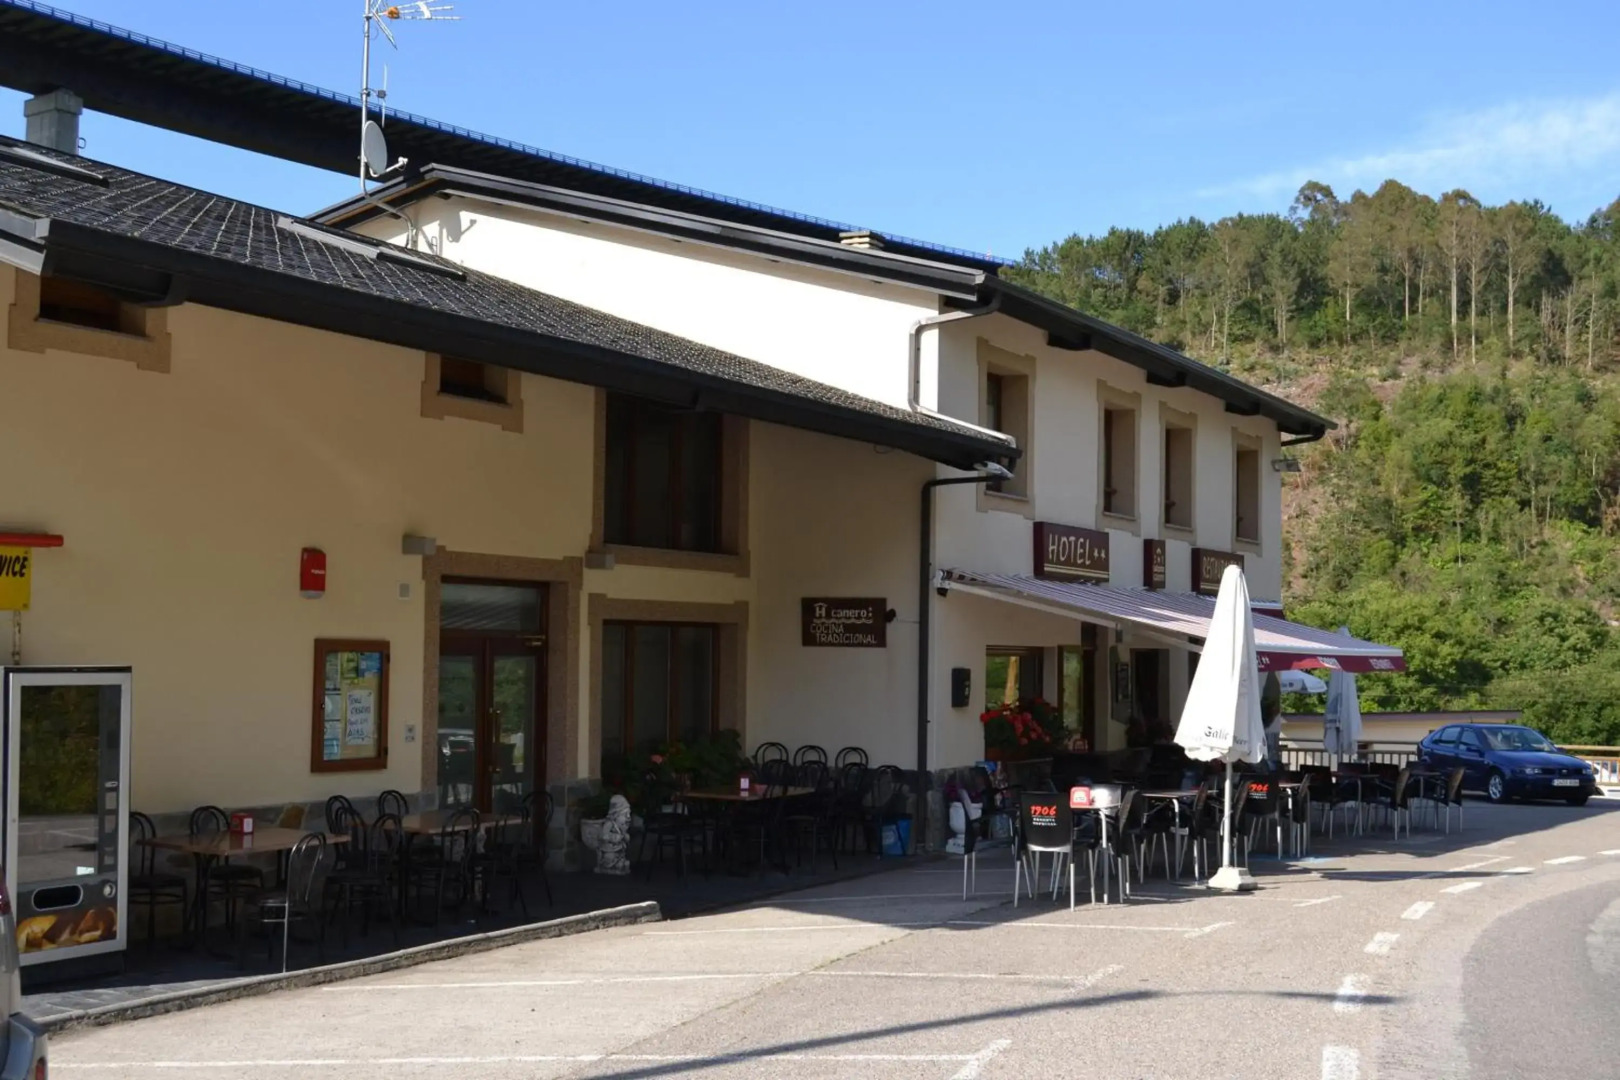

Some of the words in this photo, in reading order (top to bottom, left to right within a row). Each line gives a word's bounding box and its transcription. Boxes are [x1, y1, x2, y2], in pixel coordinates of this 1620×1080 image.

[1048, 533, 1091, 566] HOTEL
[831, 609, 867, 617] canero
[810, 624, 844, 633] COCINA
[816, 634, 877, 643] TRADICIONAL
[1030, 805, 1057, 815] 1906
